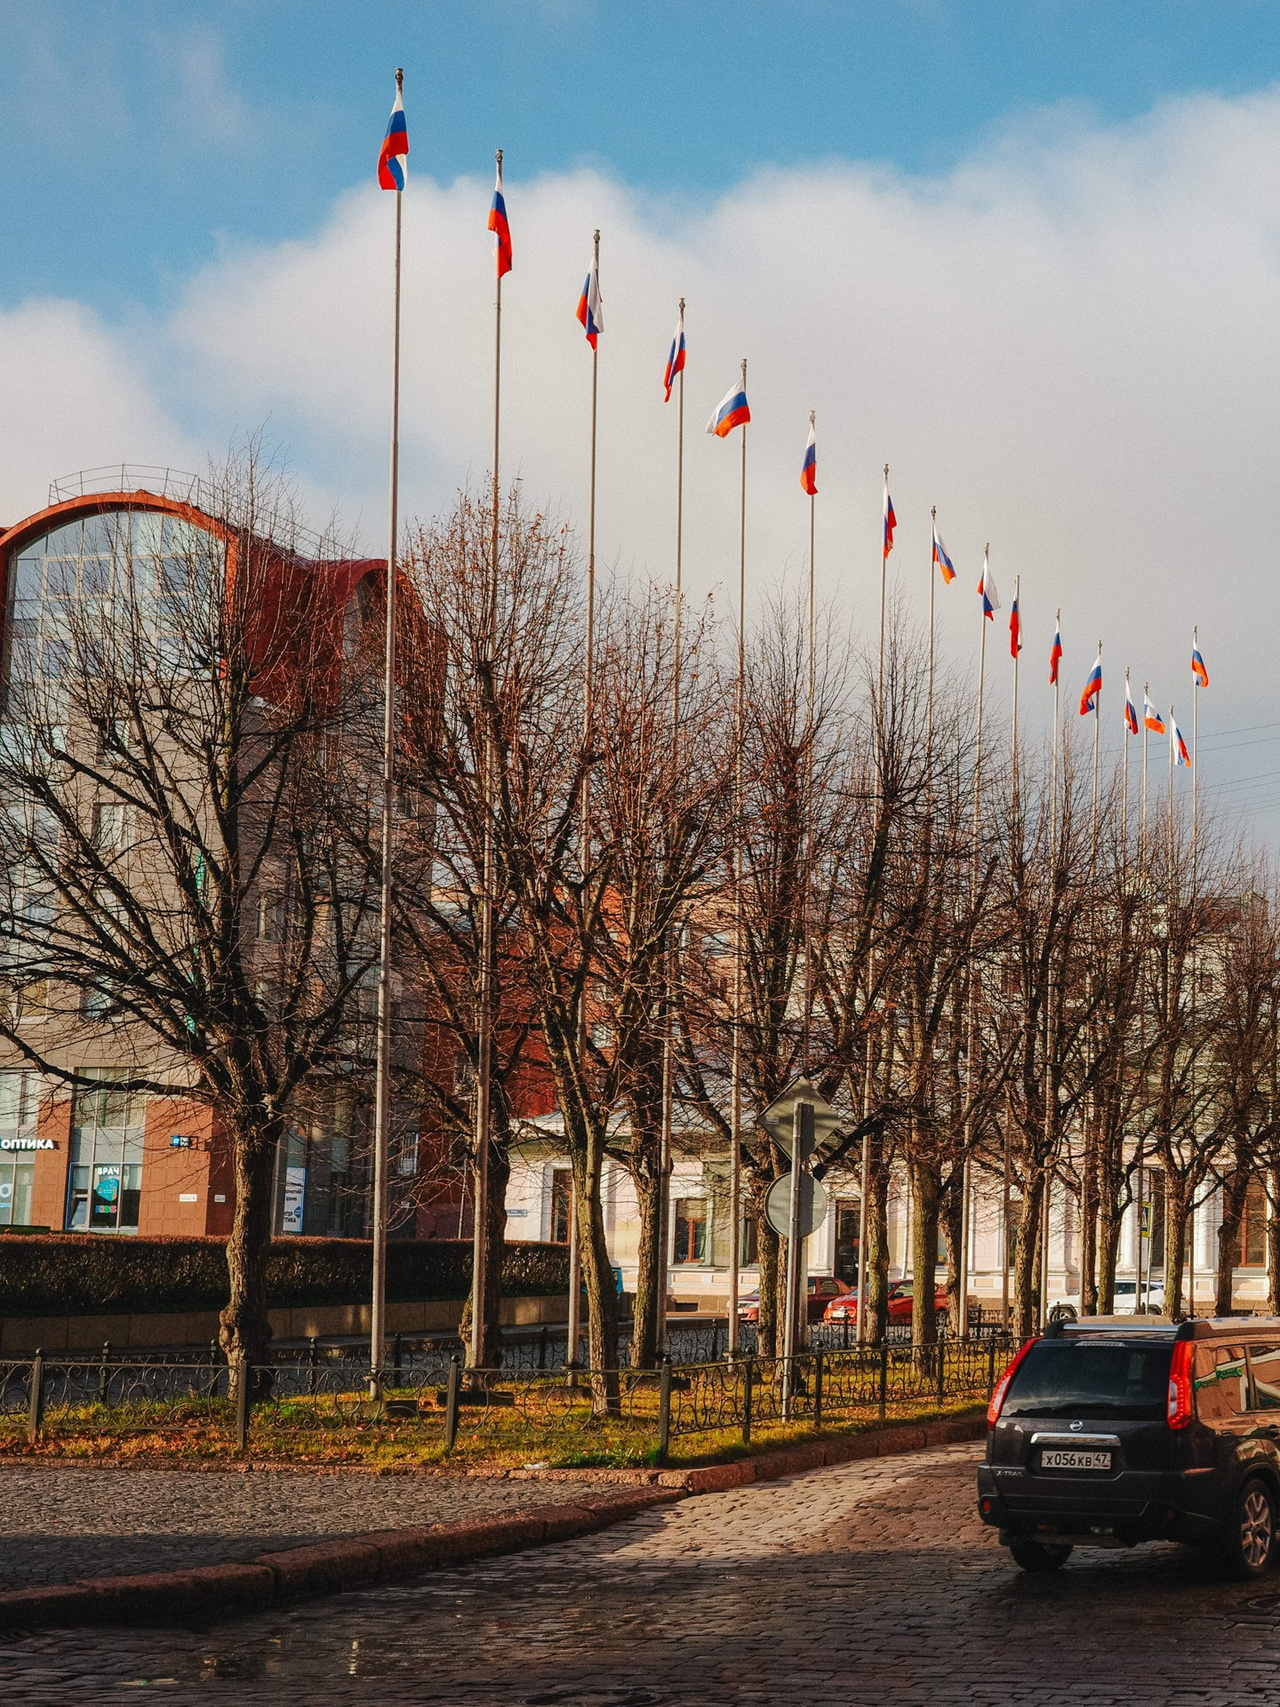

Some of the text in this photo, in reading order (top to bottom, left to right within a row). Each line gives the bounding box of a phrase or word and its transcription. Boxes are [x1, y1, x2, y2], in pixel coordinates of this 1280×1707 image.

[0, 1139, 54, 1149] ОПТИКА
[97, 1167, 120, 1175] ВРАЧ
[1095, 1453, 1107, 1464] 47
